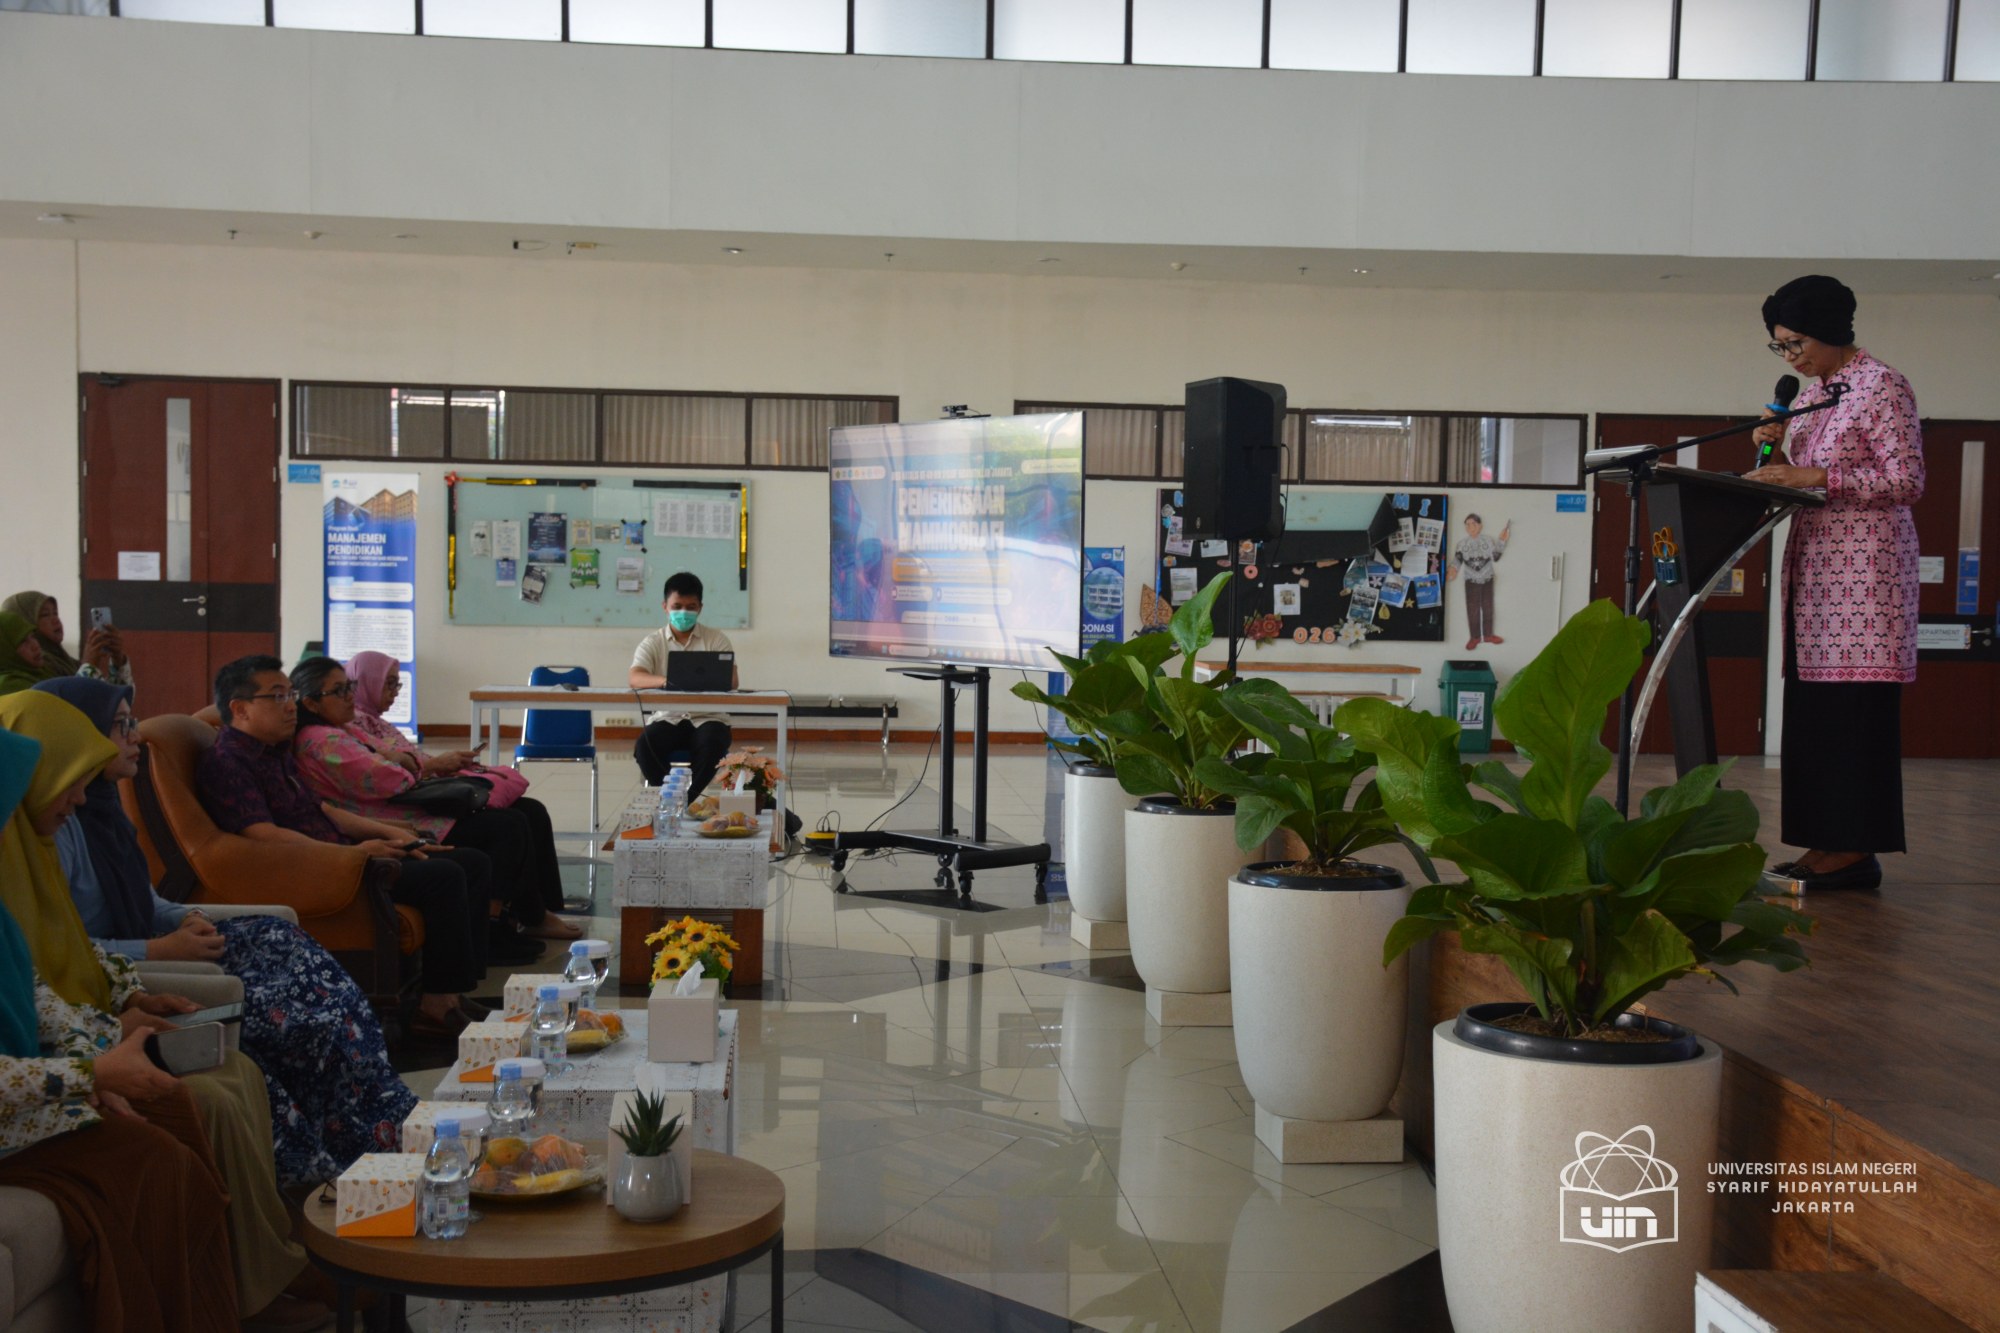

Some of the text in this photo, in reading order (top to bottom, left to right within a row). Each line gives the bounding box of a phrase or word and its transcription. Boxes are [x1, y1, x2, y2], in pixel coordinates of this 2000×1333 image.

[898, 484, 1005, 516] PEMERIKSAAN
[327, 533, 387, 544] MANAJEMEN
[327, 544, 383, 555] PENDIDIKAN
[1293, 626, 1336, 644] 026
